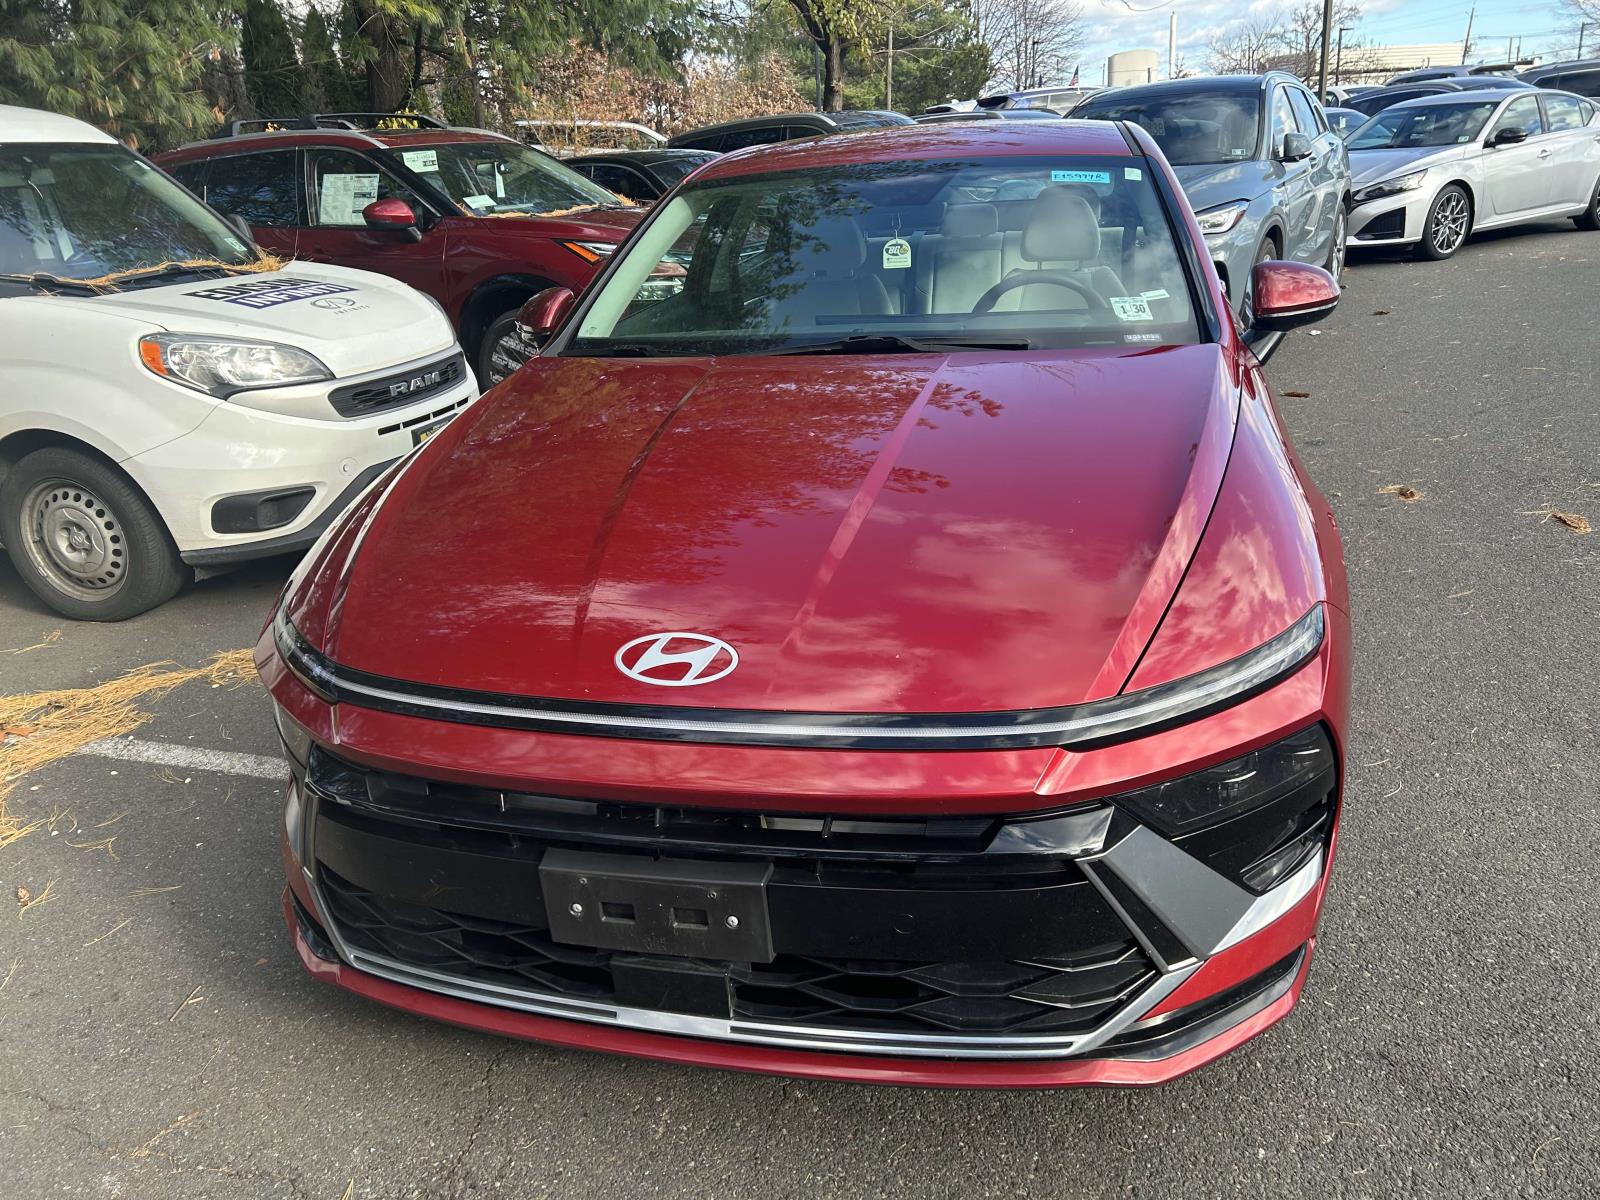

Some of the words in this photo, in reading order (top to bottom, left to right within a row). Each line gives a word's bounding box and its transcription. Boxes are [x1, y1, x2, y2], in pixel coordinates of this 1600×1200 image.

[194, 278, 318, 300] EDISON
[236, 284, 351, 307] INFINITI
[1132, 303, 1146, 314] 30
[389, 371, 441, 397] RAM
